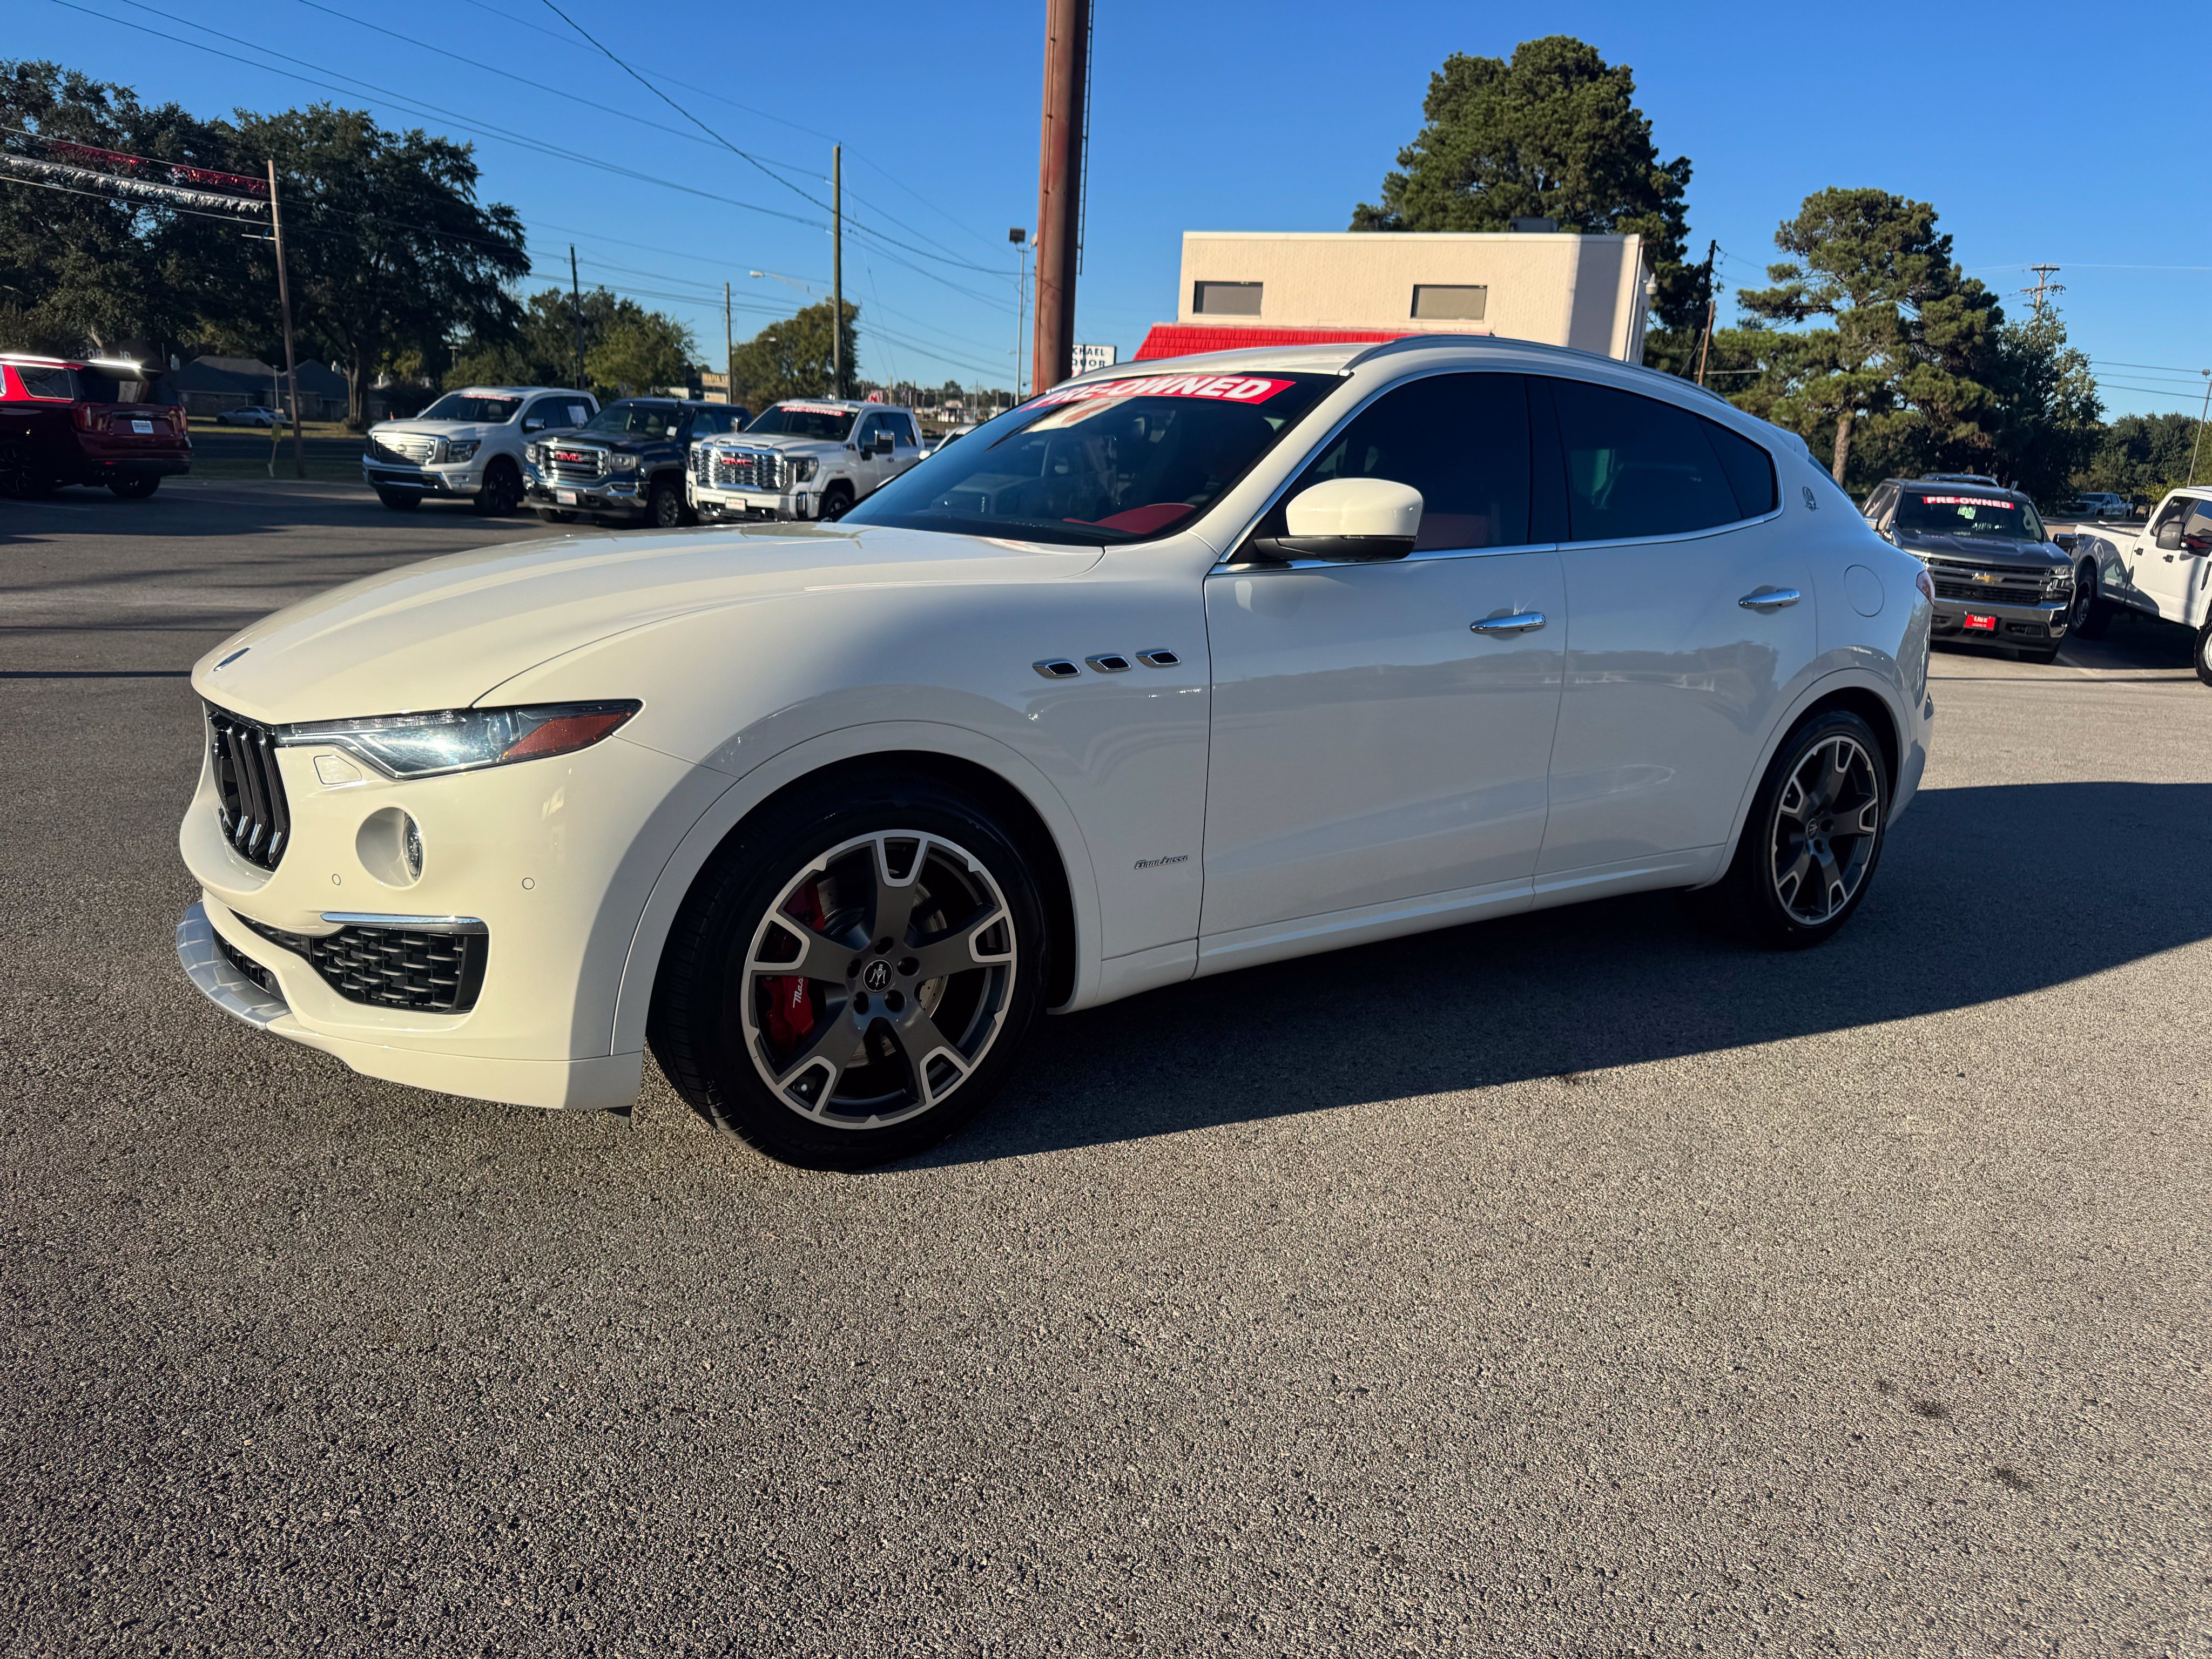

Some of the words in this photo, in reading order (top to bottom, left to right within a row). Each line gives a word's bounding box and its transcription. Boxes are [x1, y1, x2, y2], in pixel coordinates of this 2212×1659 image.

[1033, 377, 1272, 409] PRE-OWNED
[783, 407, 842, 416] PRE-OWNED
[555, 450, 583, 463] GMC
[720, 457, 753, 468] GMC
[1926, 496, 2011, 509] PRE-OWNED
[792, 976, 804, 1008] Mas
